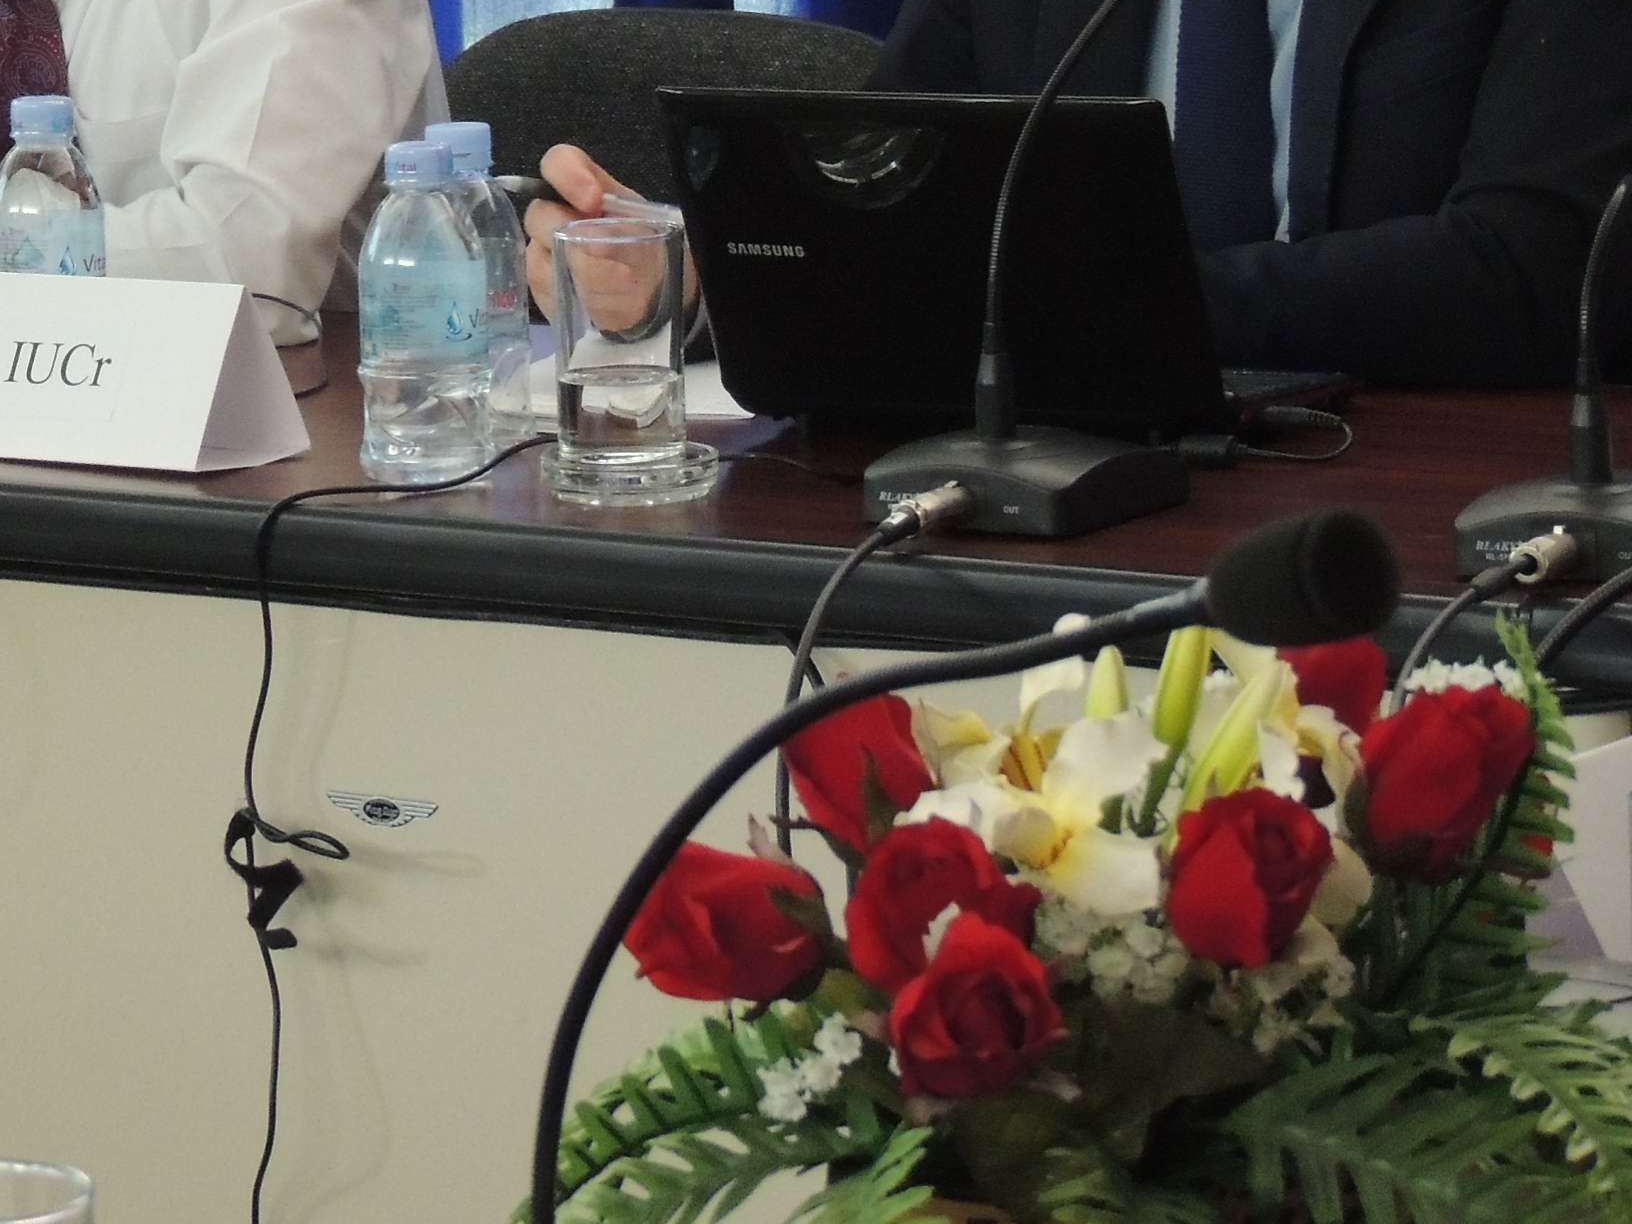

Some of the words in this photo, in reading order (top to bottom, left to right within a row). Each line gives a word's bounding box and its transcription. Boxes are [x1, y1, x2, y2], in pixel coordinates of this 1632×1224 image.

[727, 241, 805, 258] SAMSUNG
[2, 340, 113, 387] IUCr
[1002, 506, 1020, 516] OUT
